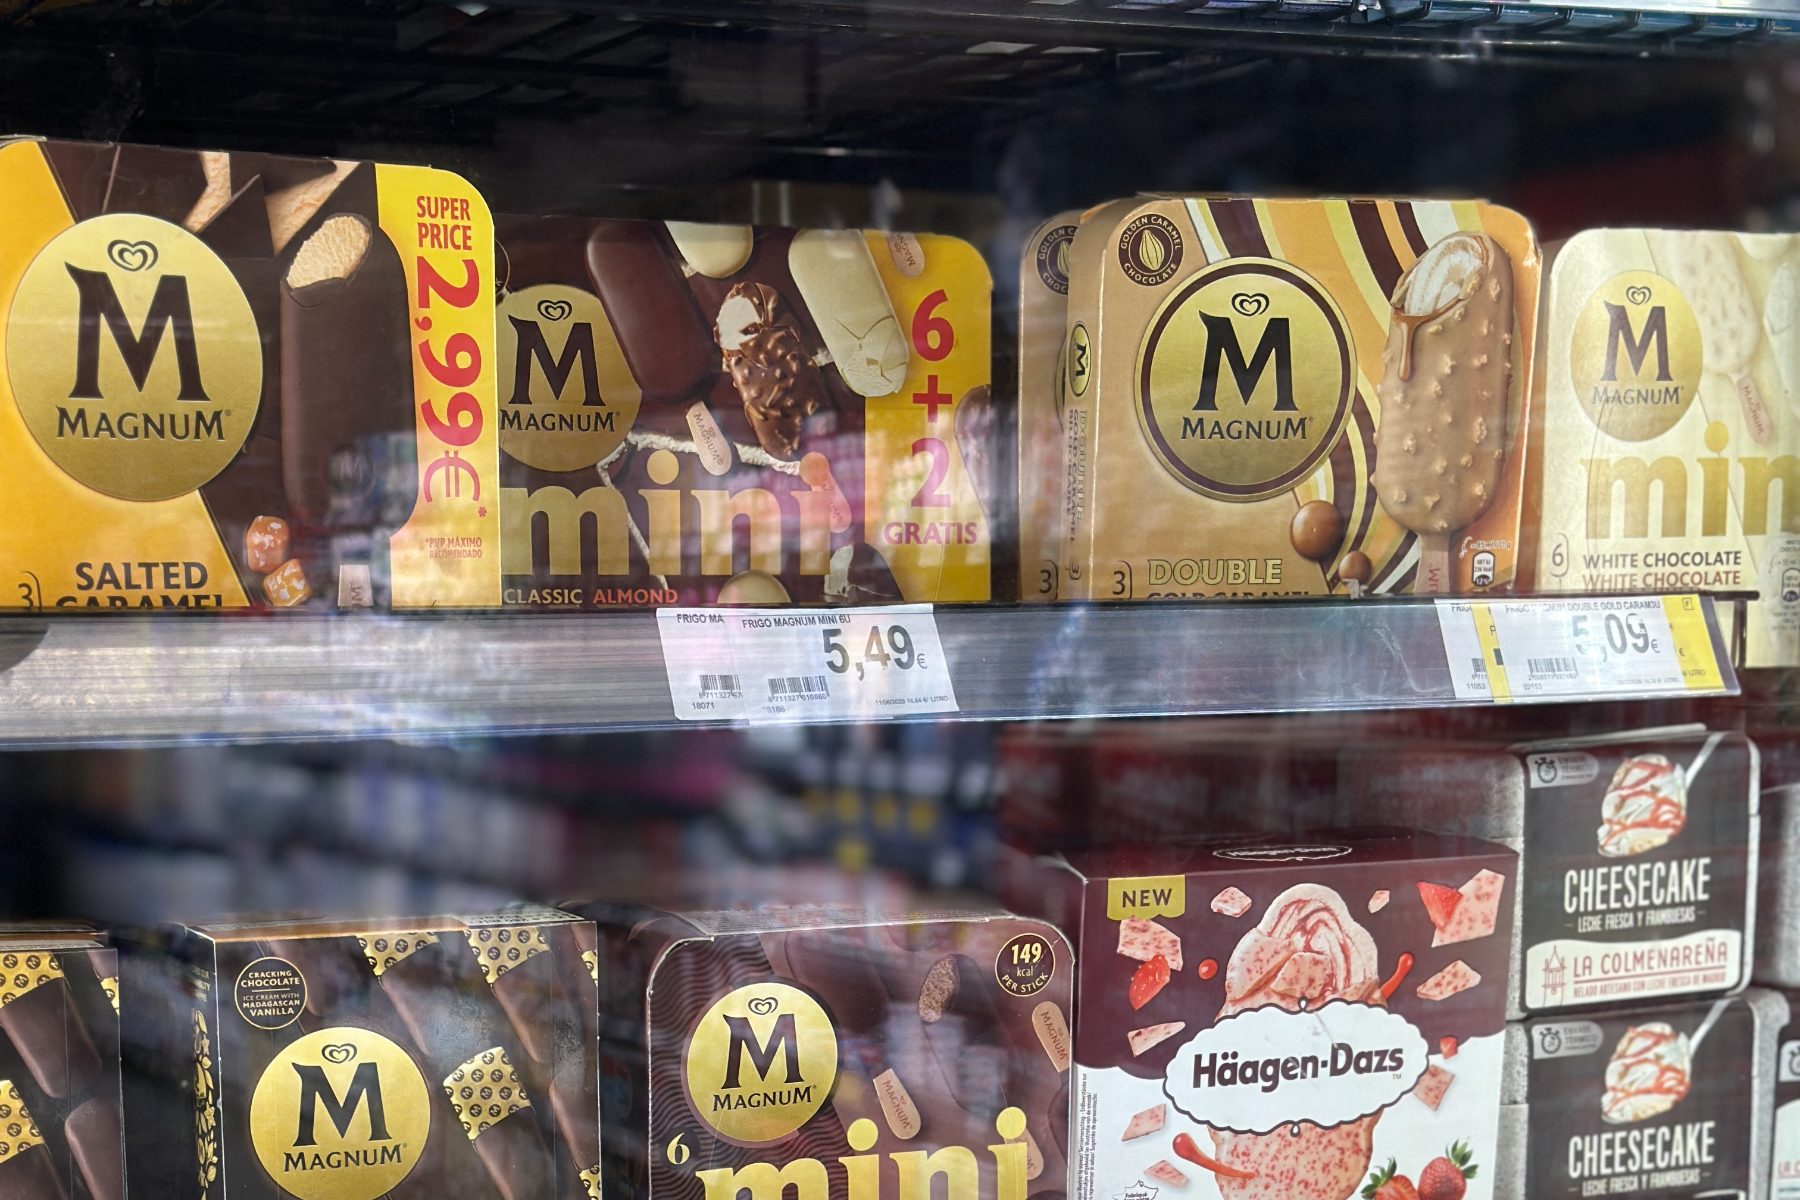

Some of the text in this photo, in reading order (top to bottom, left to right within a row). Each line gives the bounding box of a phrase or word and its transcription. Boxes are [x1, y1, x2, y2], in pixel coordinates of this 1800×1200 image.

[416, 195, 471, 221] SUPER
[417, 223, 472, 251] PRICE
[1039, 229, 1065, 260] GOLDEN
[1120, 216, 1181, 250] GOLDEN CARAMEL
[1123, 263, 1177, 284] CHOCOLATE
[65, 262, 211, 402] M
[911, 288, 955, 362] 6
[1600, 302, 1674, 382] M
[508, 315, 607, 407] M
[1192, 309, 1299, 412] M
[1592, 385, 1681, 406] MAGNUM
[56, 406, 226, 441] MAGNUM
[500, 410, 616, 433] MAGNUM
[1180, 415, 1308, 441] MAGNUM
[910, 436, 951, 508] 2
[500, 449, 831, 576] mini
[448, 536, 481, 548] MÁXIMO
[883, 522, 979, 546] GRATIS
[1148, 559, 1282, 585] DOUBLE
[1583, 551, 1742, 569] WHITE CHOCOLATE
[76, 562, 208, 591] SALTED
[1112, 571, 1126, 595] 3
[1582, 571, 1741, 591] WHITE CHOCOLATE
[503, 588, 678, 606] CLASSIC ALMOND
[677, 613, 707, 624] FRIGO
[742, 613, 851, 630] FRIGO MAGNUM MINI 6U
[692, 701, 715, 710] 18071
[1121, 889, 1172, 908] NEW
[1563, 857, 1711, 914] CHEESECAKE
[1578, 906, 1696, 933] LECHE FRESCA Y FRAMBUESAS
[1011, 942, 1042, 965] 149
[1573, 937, 1728, 978] LA COLMENAREÑA
[241, 978, 300, 988] CHOCOLATE
[249, 970, 292, 978] CRACKING
[1002, 973, 1048, 993] PER STICK
[1016, 966, 1034, 977] kcal
[243, 1000, 300, 1008] MADAGASCAN
[250, 1008, 294, 1016] VANILLA
[722, 1012, 804, 1090] M
[1192, 1042, 1404, 1094] Häagen-Dazs
[292, 1062, 392, 1147] M
[712, 1087, 812, 1112] MAGNUM
[883, 1079, 911, 1129] MAGNUM
[283, 1144, 403, 1173] MAGNUM
[666, 1132, 691, 1165] 6
[1568, 1121, 1716, 1179] CHEESECAKE
[1582, 1179, 1608, 1197] LECHE
